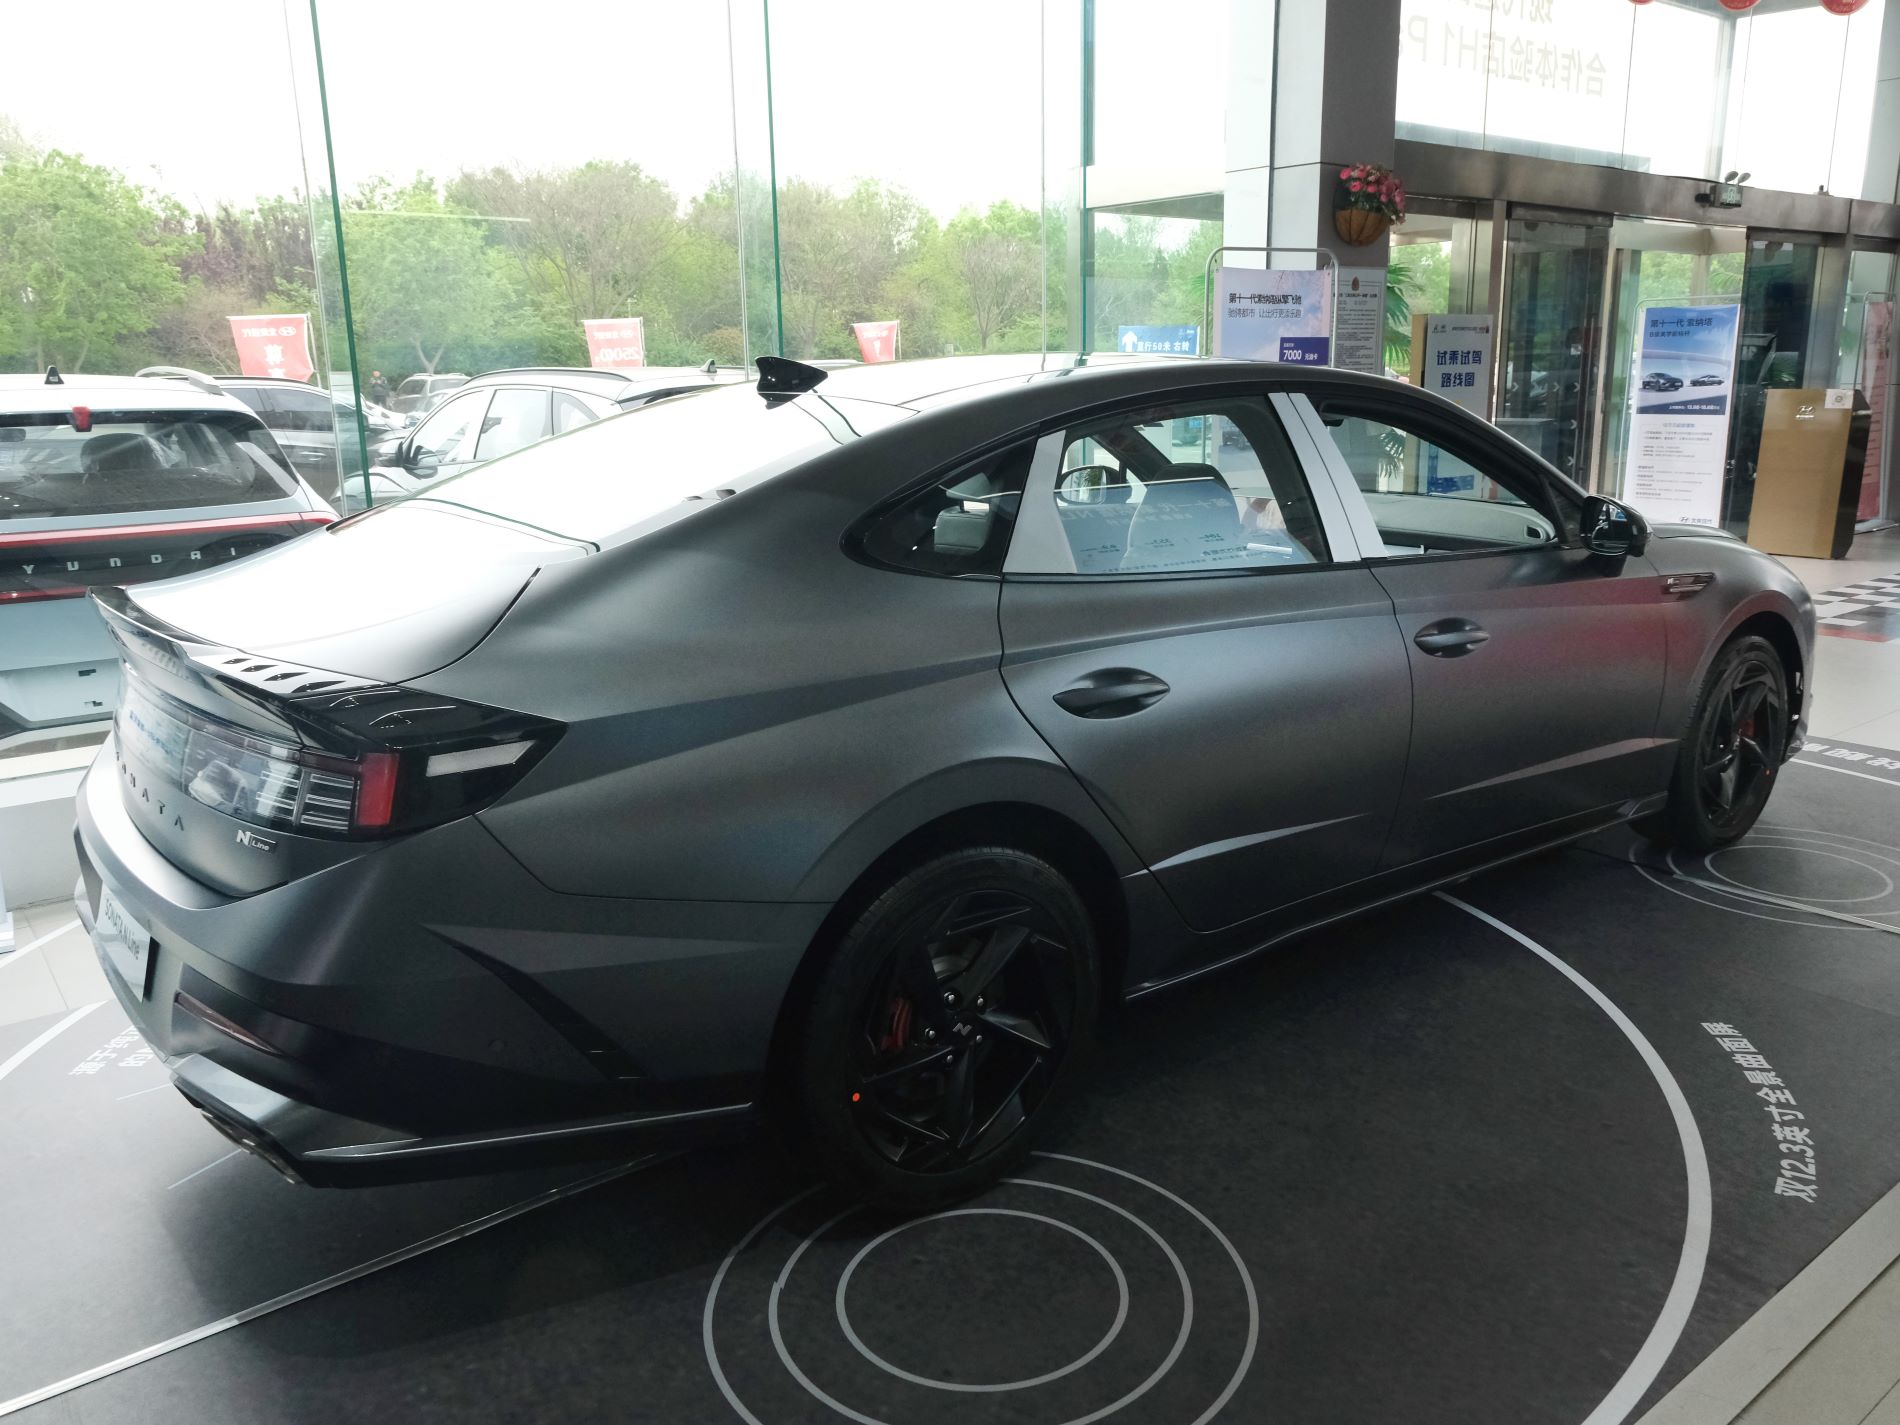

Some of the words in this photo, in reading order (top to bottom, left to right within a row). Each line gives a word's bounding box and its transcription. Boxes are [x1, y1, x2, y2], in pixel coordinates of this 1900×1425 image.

[1650, 319, 1685, 328] 第十一代
[1283, 350, 1302, 360] 7000
[1436, 350, 1482, 366] 试乘试驾
[1441, 372, 1475, 388] 路线图
[252, 840, 270, 851] Line
[1700, 1022, 1819, 1204] 双12.3英寸全景曲面屏
